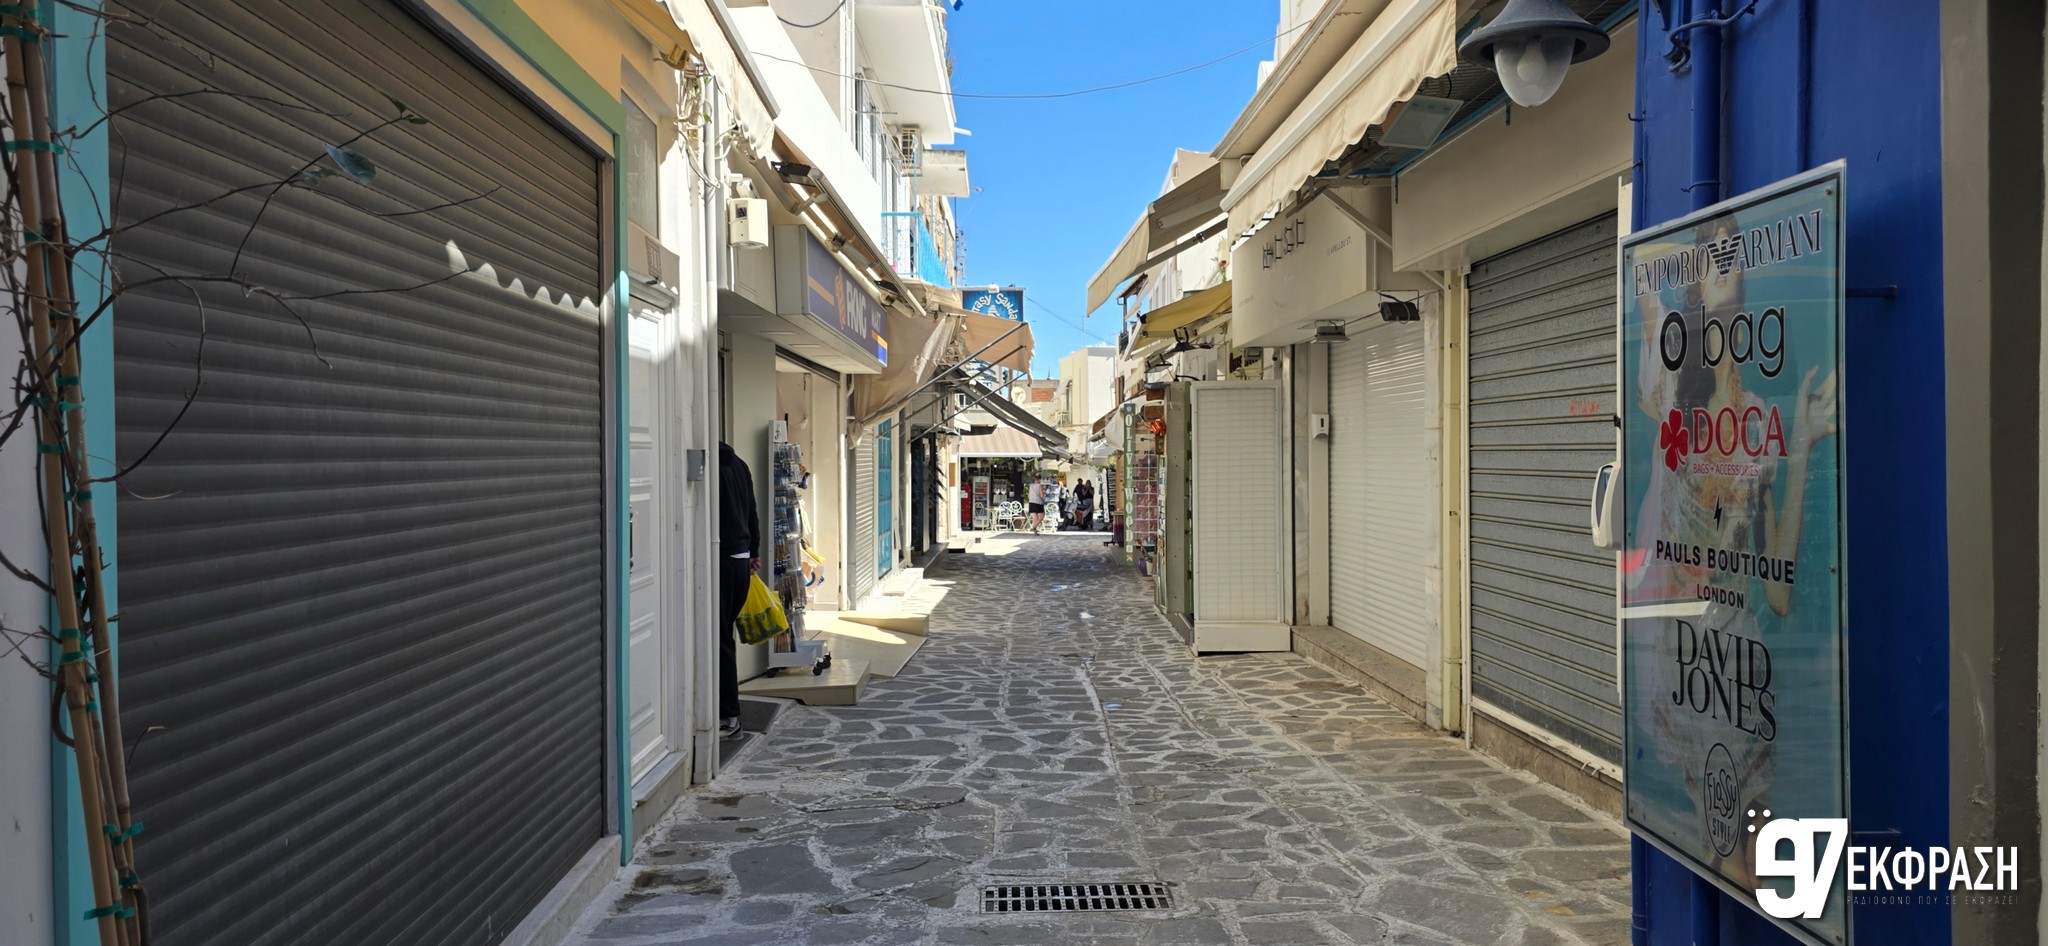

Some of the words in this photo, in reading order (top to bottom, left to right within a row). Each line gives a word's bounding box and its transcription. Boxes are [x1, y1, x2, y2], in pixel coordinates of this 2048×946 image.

[1634, 245, 1710, 296] EMPORIO
[1736, 210, 1822, 270] ARMANI
[1660, 310, 1687, 372] O
[1701, 305, 1786, 378] bag
[1125, 414, 1134, 478] OLIVE
[1692, 405, 1788, 457] DOCA
[1693, 463, 1710, 474] BAGS
[1715, 463, 1760, 477] ACCESSORIES
[1124, 487, 1134, 541] WOOD
[1656, 540, 1701, 567] PAULS
[1708, 548, 1795, 585] BOUTIQUE
[1696, 583, 1745, 610] LONDON
[1676, 619, 1773, 693] DAVID
[1672, 661, 1778, 742] JONES
[1713, 817, 1731, 845] STYLE
